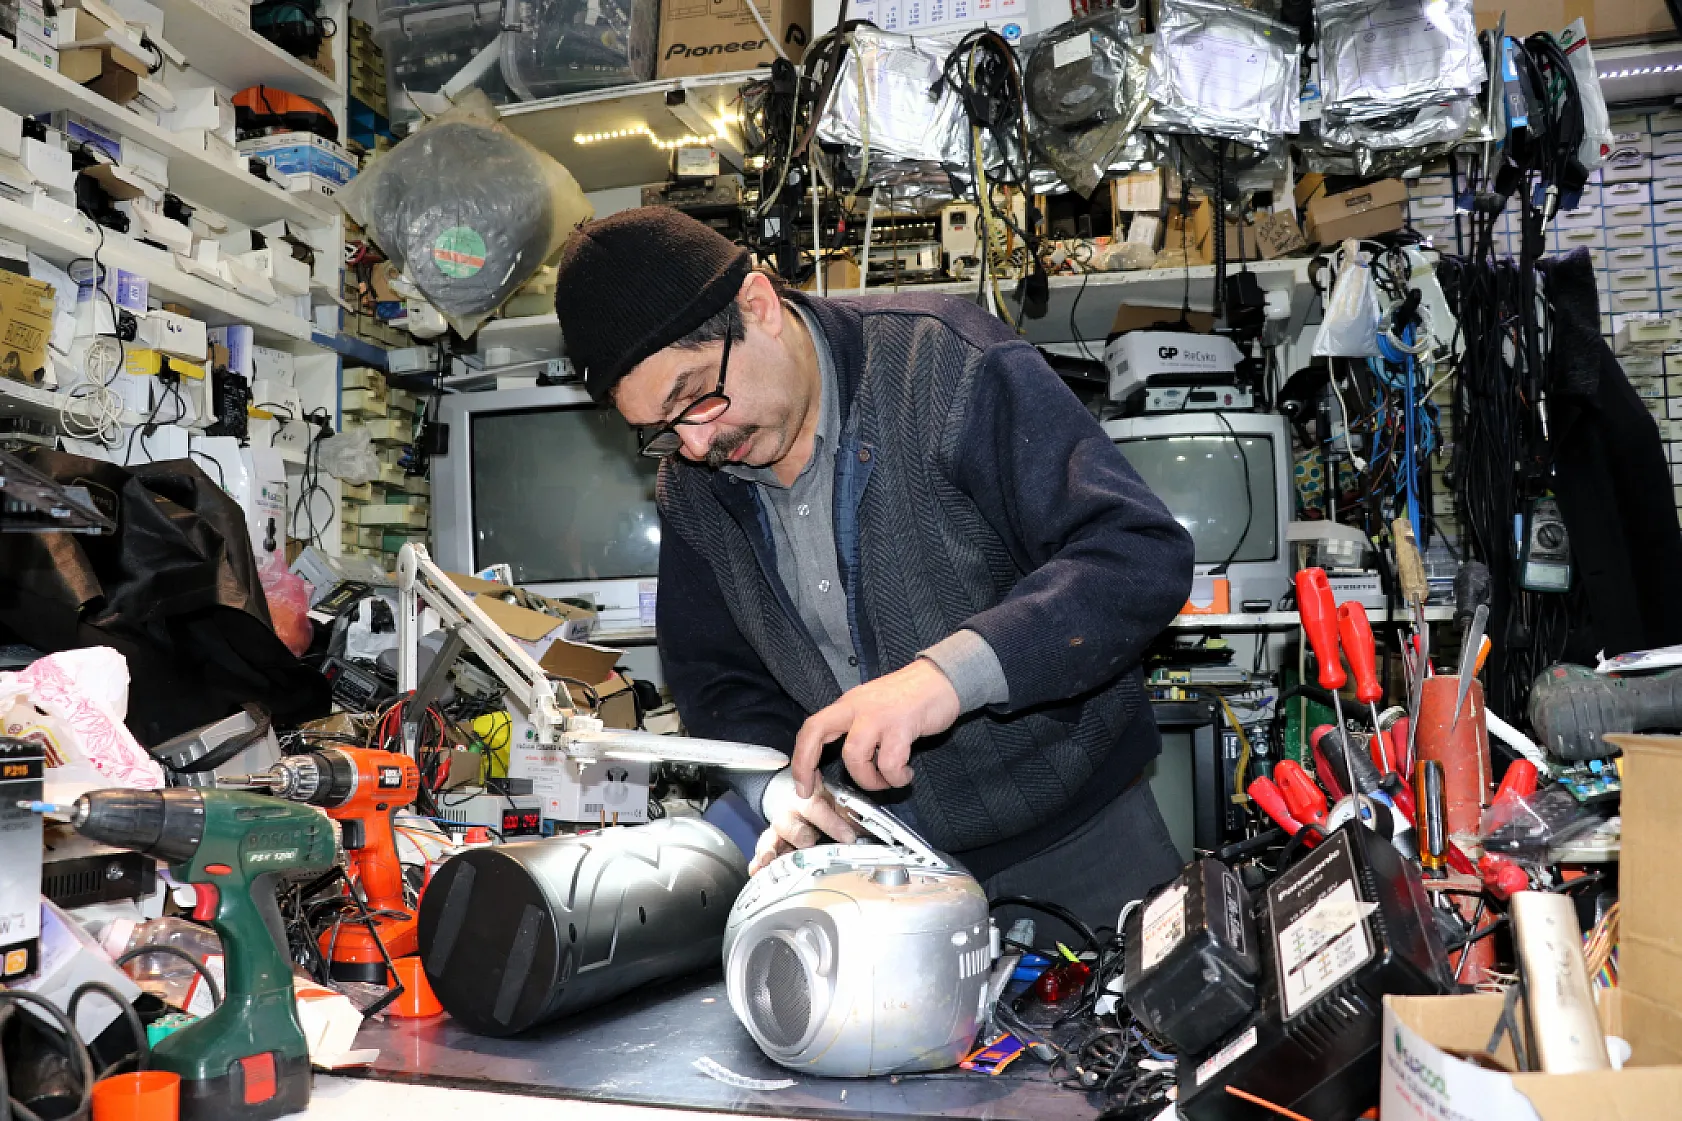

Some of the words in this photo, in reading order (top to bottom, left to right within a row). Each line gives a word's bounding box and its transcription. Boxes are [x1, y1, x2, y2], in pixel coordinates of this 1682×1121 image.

[665, 39, 769, 61] Pioneer
[1158, 346, 1179, 359] GP
[1277, 849, 1340, 902] Panasonic
